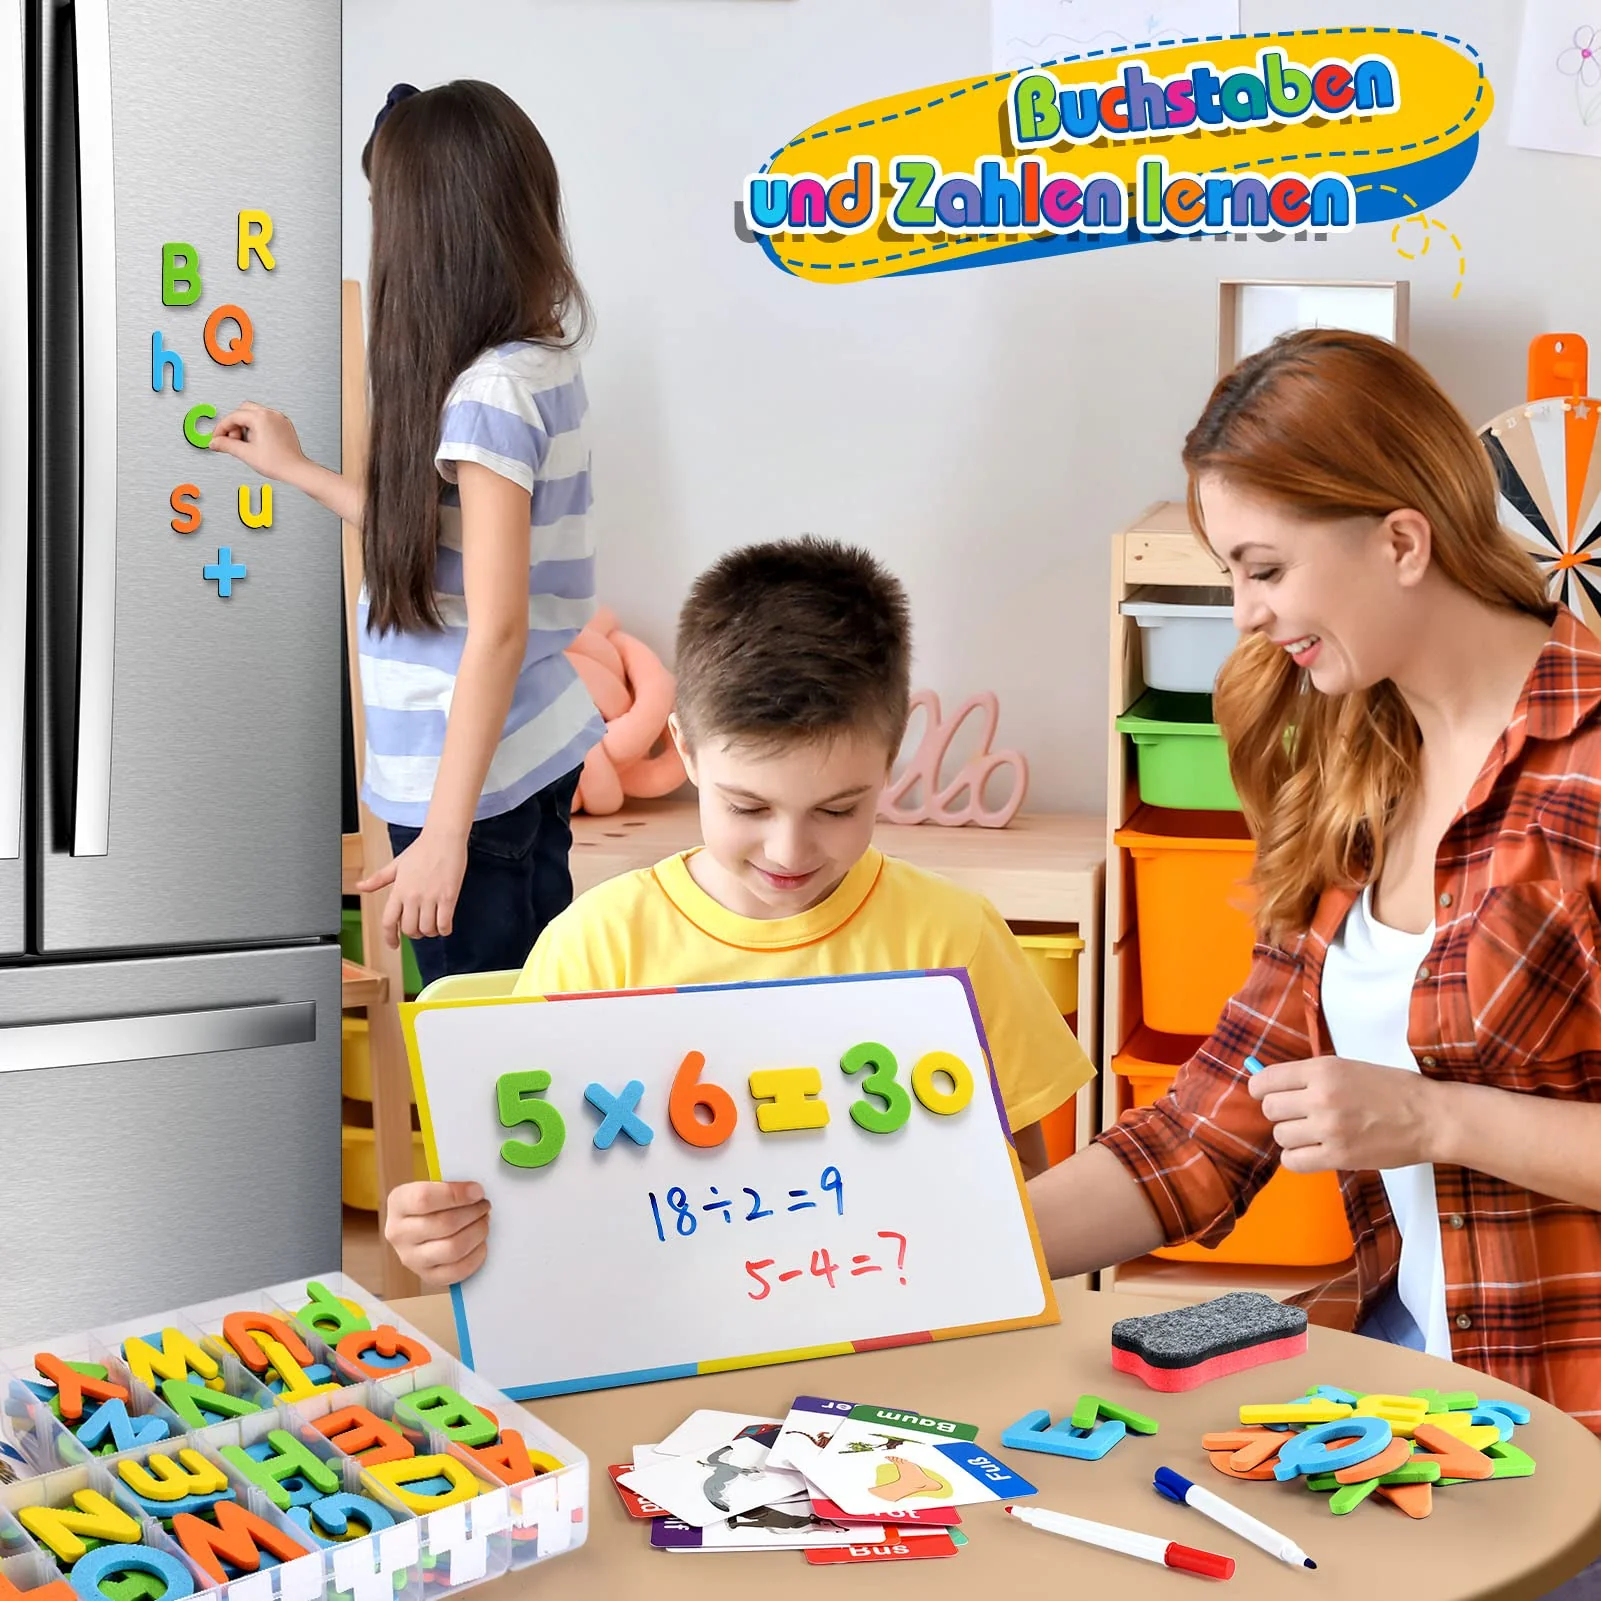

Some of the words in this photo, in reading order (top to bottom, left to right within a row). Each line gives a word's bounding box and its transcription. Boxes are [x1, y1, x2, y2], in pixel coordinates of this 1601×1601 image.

[237, 209, 276, 271] R
[162, 242, 203, 307] B
[151, 330, 184, 392] h
[203, 304, 254, 367] Q
[876, 1410, 957, 1433] Baum
